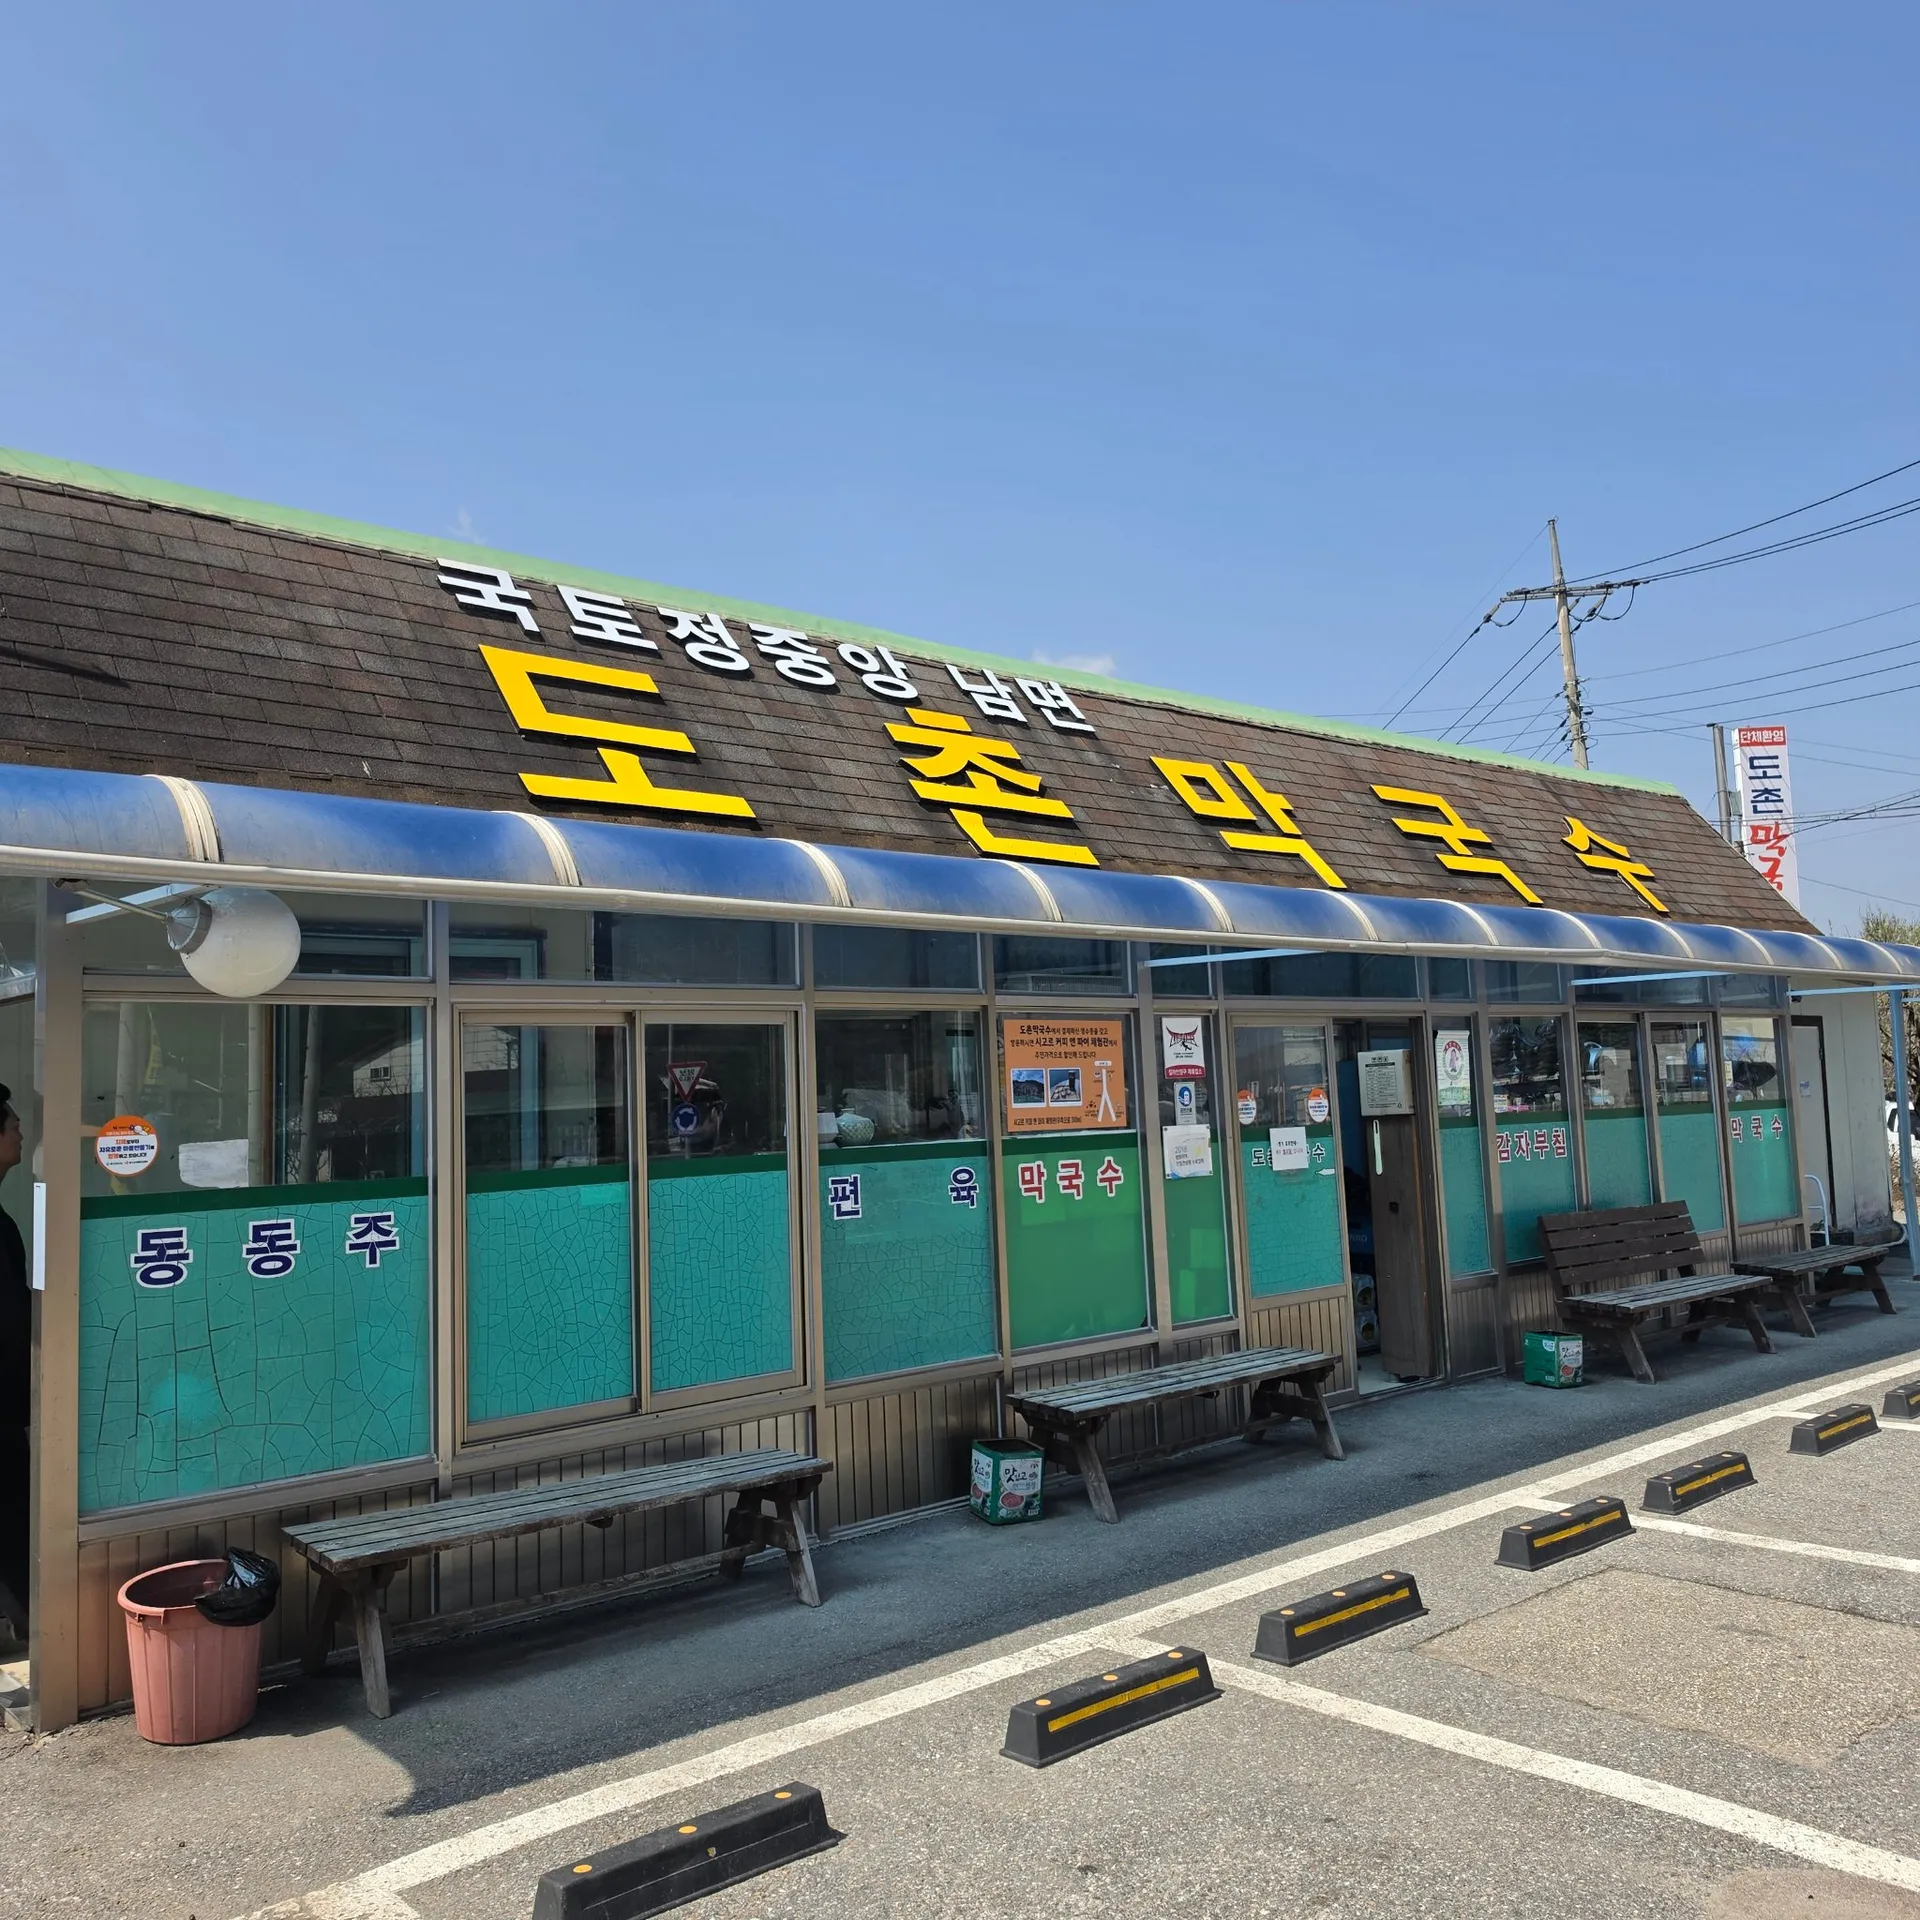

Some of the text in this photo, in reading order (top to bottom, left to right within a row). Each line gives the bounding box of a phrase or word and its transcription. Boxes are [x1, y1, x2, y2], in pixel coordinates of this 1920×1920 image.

[437, 558, 1097, 733] 국토정중앙 남면
[1740, 729, 1785, 744] 단체환영
[479, 644, 1670, 912] 도촌막국수
[1496, 1127, 1567, 1163] 감자부침
[1731, 1114, 1783, 1143] 막국수
[829, 1166, 979, 1220] 편육
[1018, 1156, 1123, 1204] 막국수
[130, 1211, 399, 1288] 동동주
